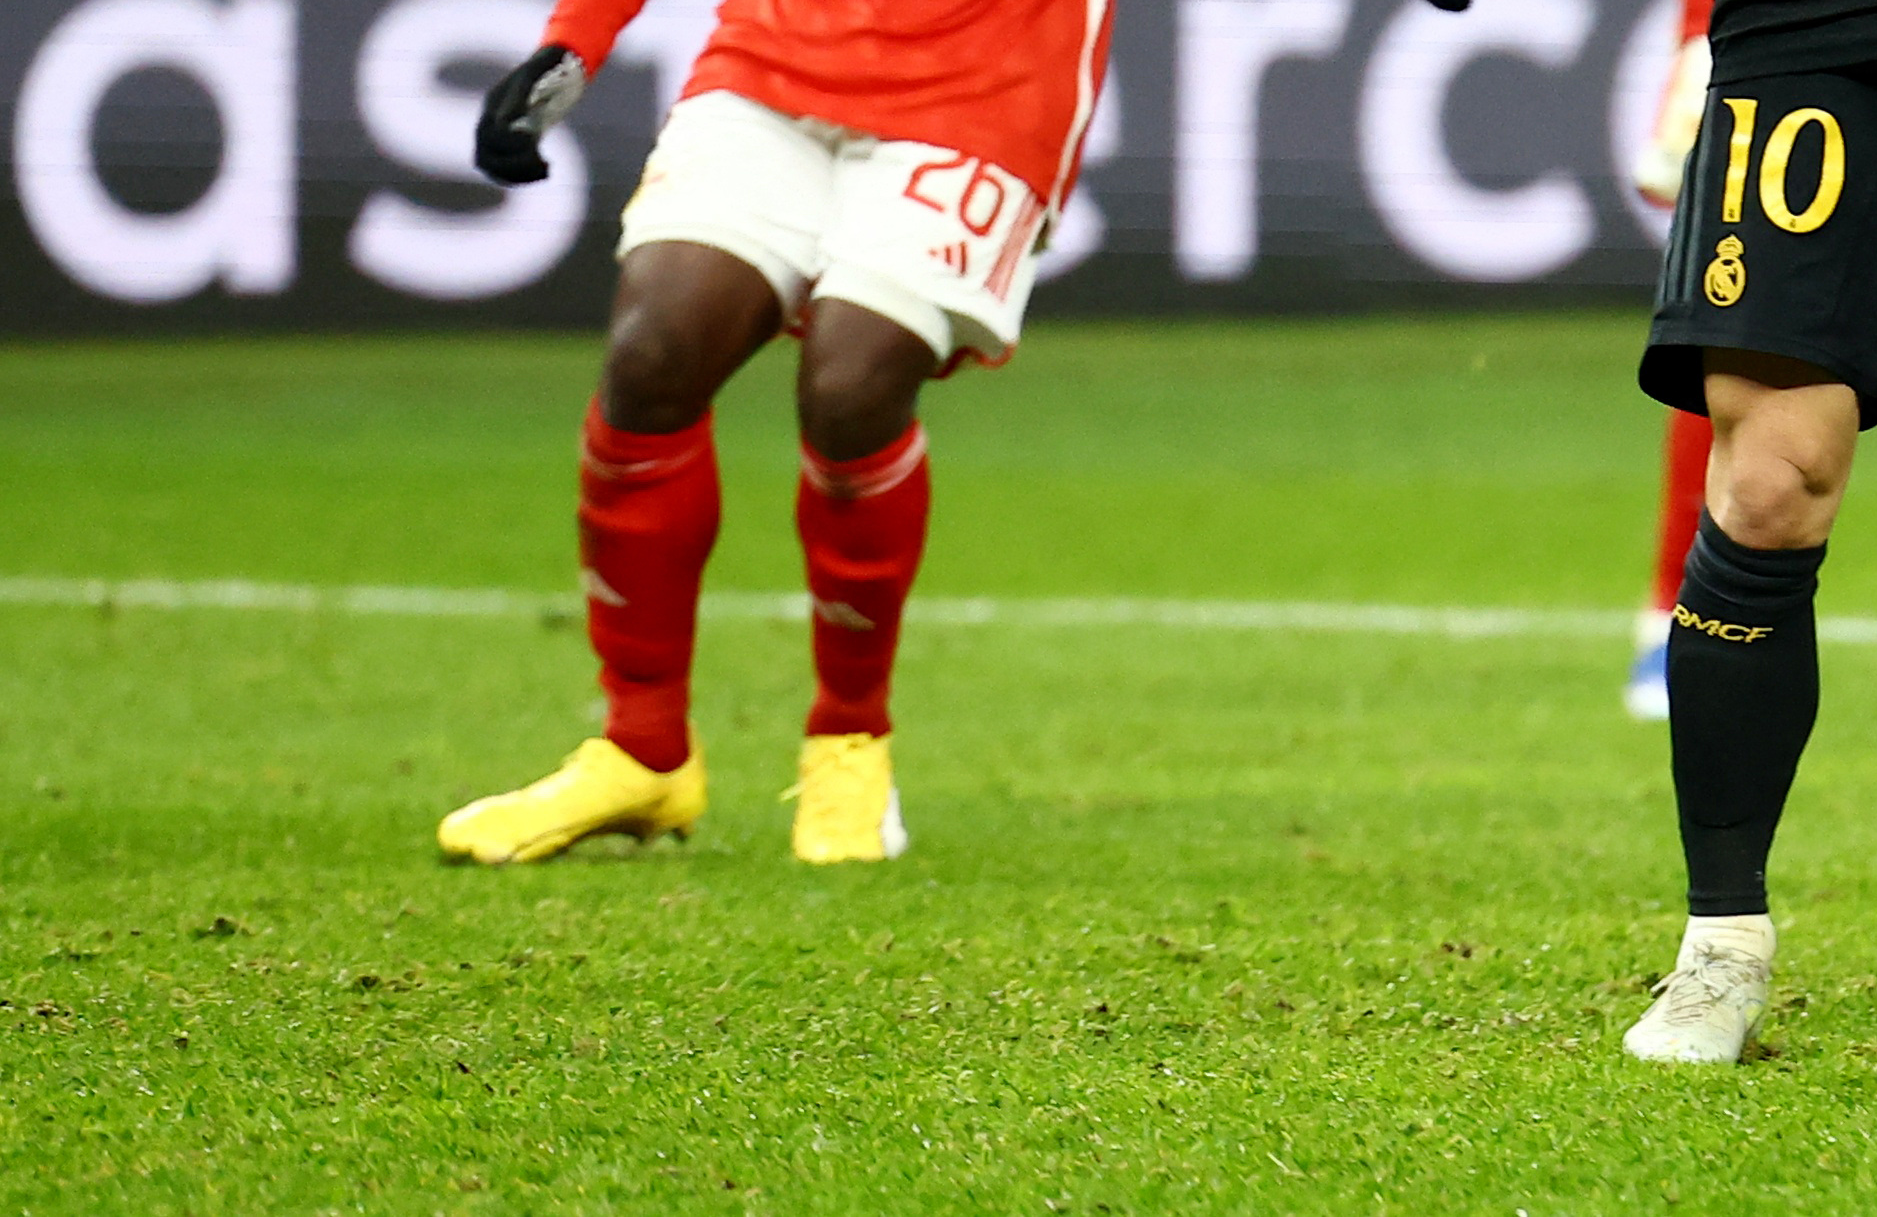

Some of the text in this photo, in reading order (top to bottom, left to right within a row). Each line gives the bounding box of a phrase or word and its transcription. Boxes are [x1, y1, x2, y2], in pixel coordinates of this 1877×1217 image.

[902, 154, 1006, 237] 26
[1722, 98, 1846, 234] 10
[1672, 603, 1774, 643] RMCF
